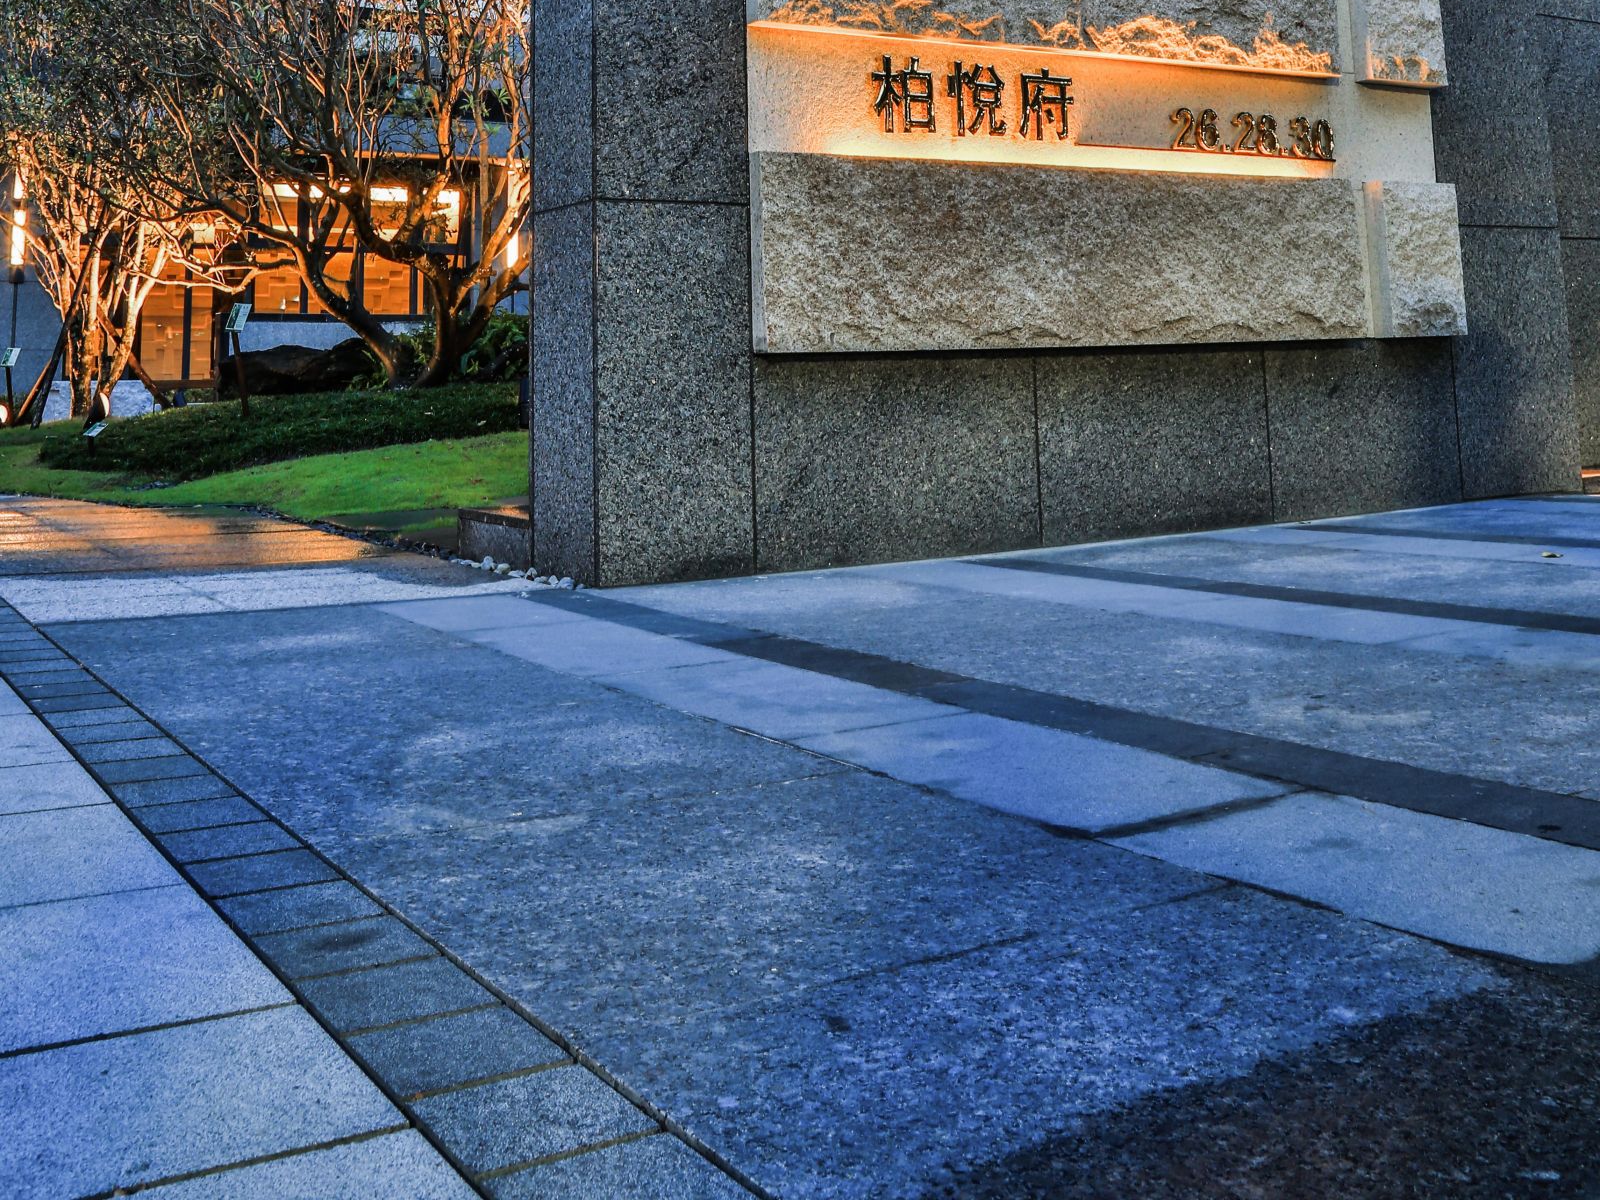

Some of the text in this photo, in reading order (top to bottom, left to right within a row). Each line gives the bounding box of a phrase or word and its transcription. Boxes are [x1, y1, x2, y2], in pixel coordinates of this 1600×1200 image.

[872, 54, 1074, 141] 柏悅府
[1170, 107, 1335, 159] 26.28.30
